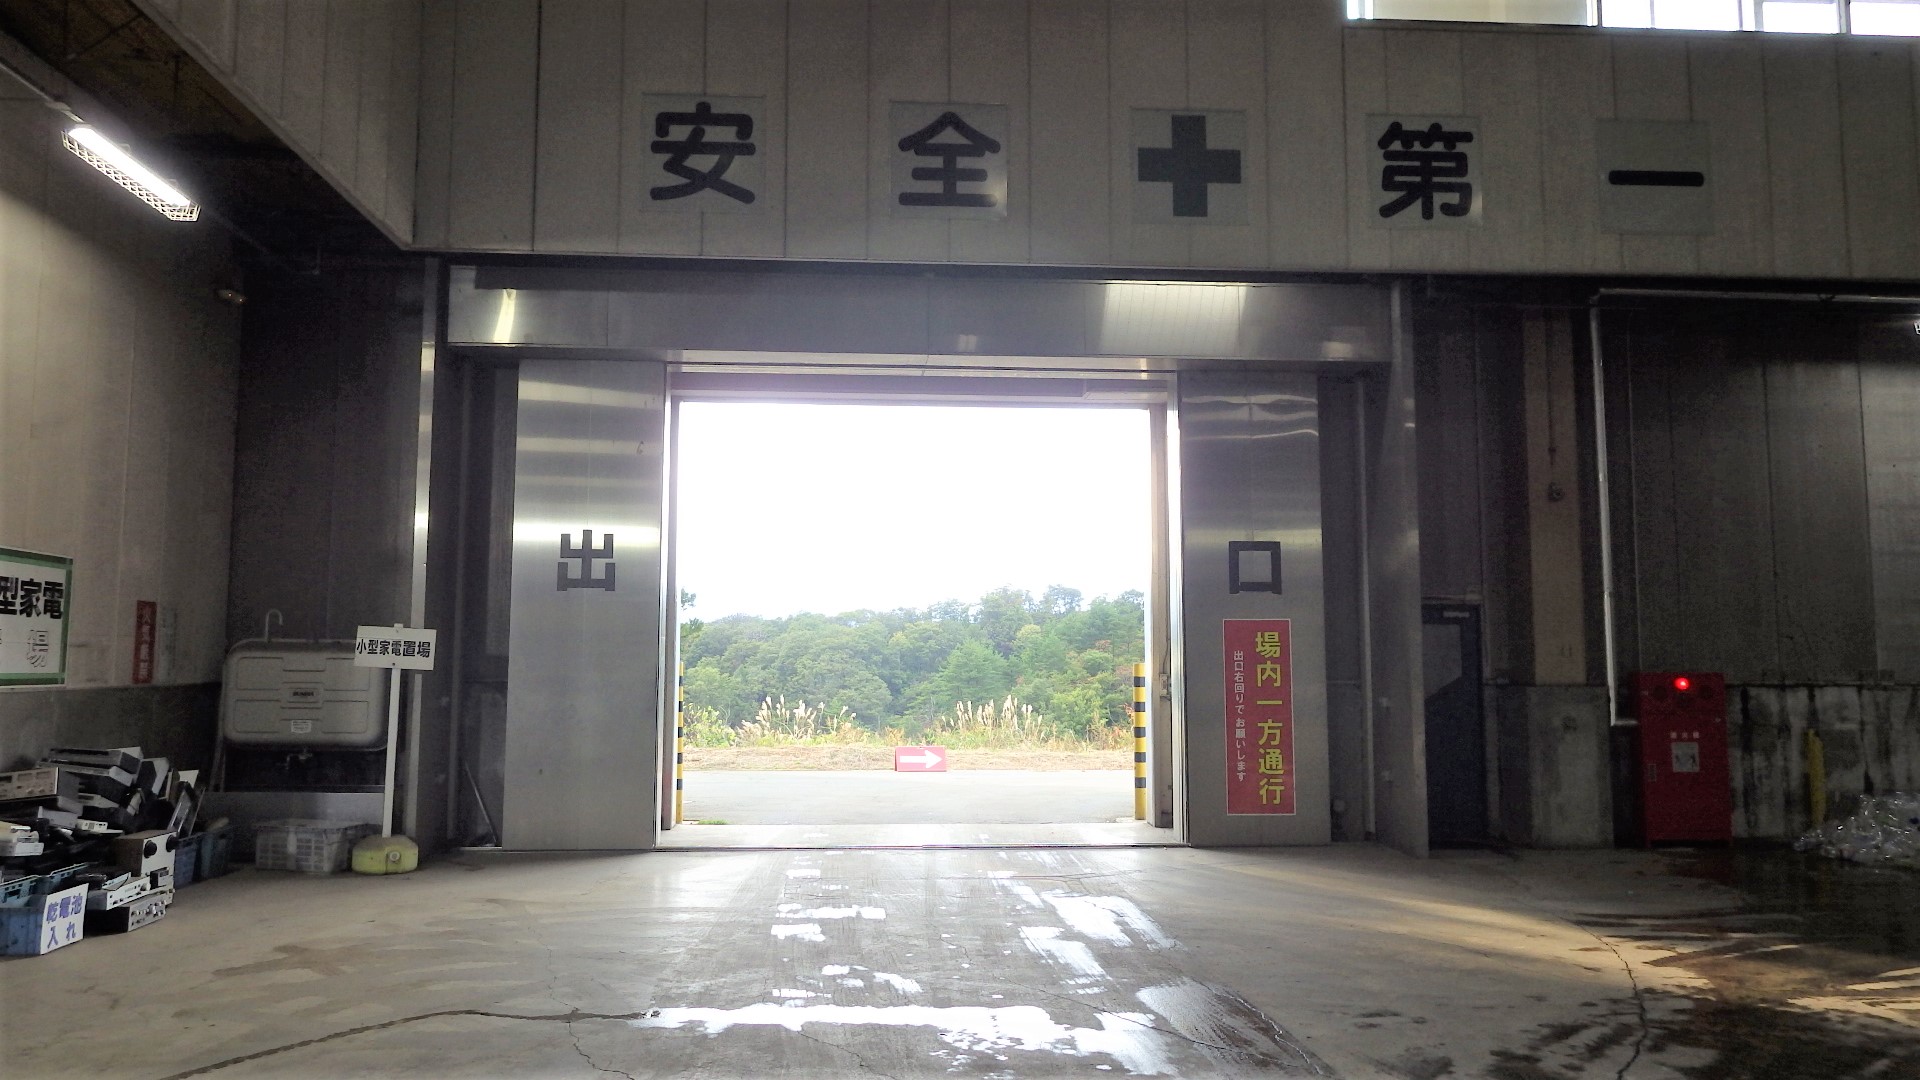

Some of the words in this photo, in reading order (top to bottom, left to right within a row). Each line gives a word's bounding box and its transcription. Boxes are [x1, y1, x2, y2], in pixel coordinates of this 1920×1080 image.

[650, 101, 1000, 208] 安全
[1377, 121, 1704, 220] 第一
[557, 530, 616, 591] 出
[1229, 541, 1281, 594] 口
[0, 575, 64, 619] 型家電
[357, 638, 431, 658] 小型家電置場
[1255, 632, 1285, 805] 場内一方通行
[46, 893, 83, 924] 乾電池
